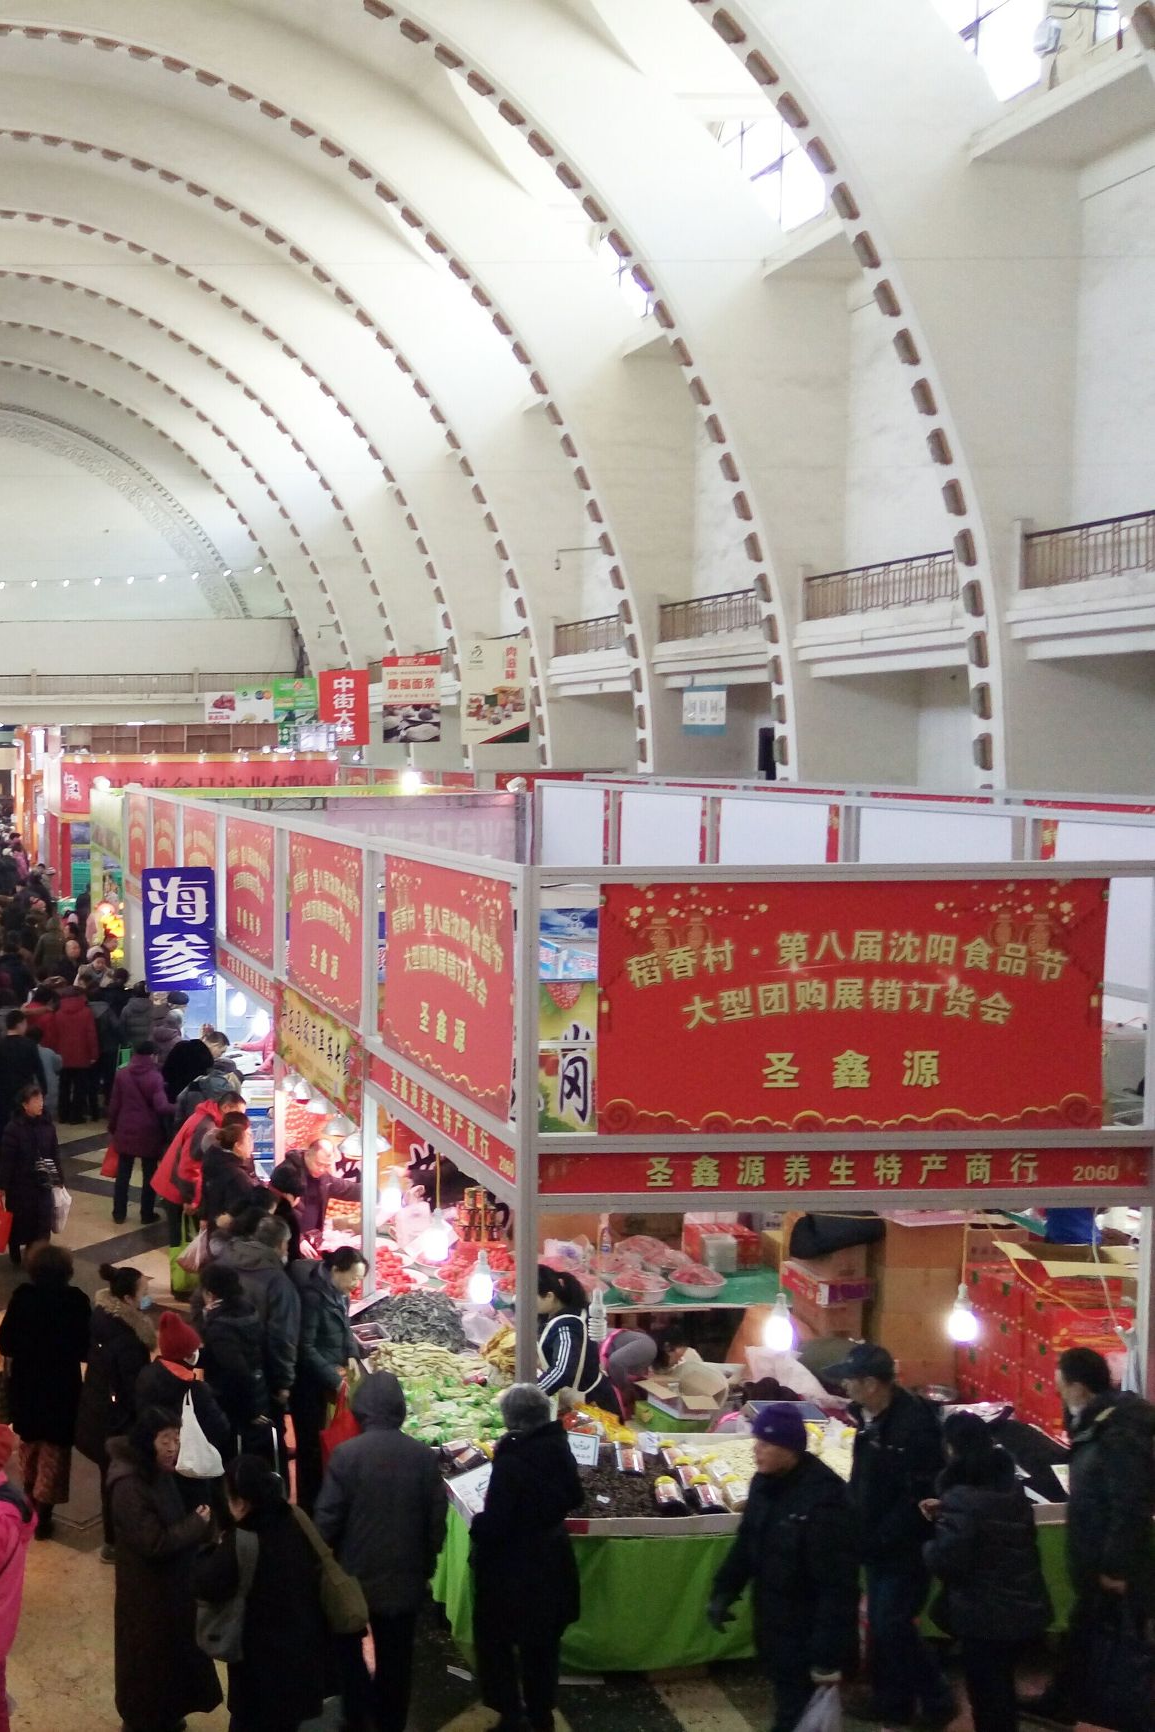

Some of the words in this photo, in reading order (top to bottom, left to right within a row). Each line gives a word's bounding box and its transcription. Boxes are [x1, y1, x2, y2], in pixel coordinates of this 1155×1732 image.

[147, 876, 210, 983] 海参
[680, 977, 1013, 1031] 大型团购展销订货会
[761, 1049, 941, 1090] 圣鑫源
[645, 1152, 1041, 1189] 圣鑫源养生特产商行
[1073, 1163, 1120, 1183] 2060
